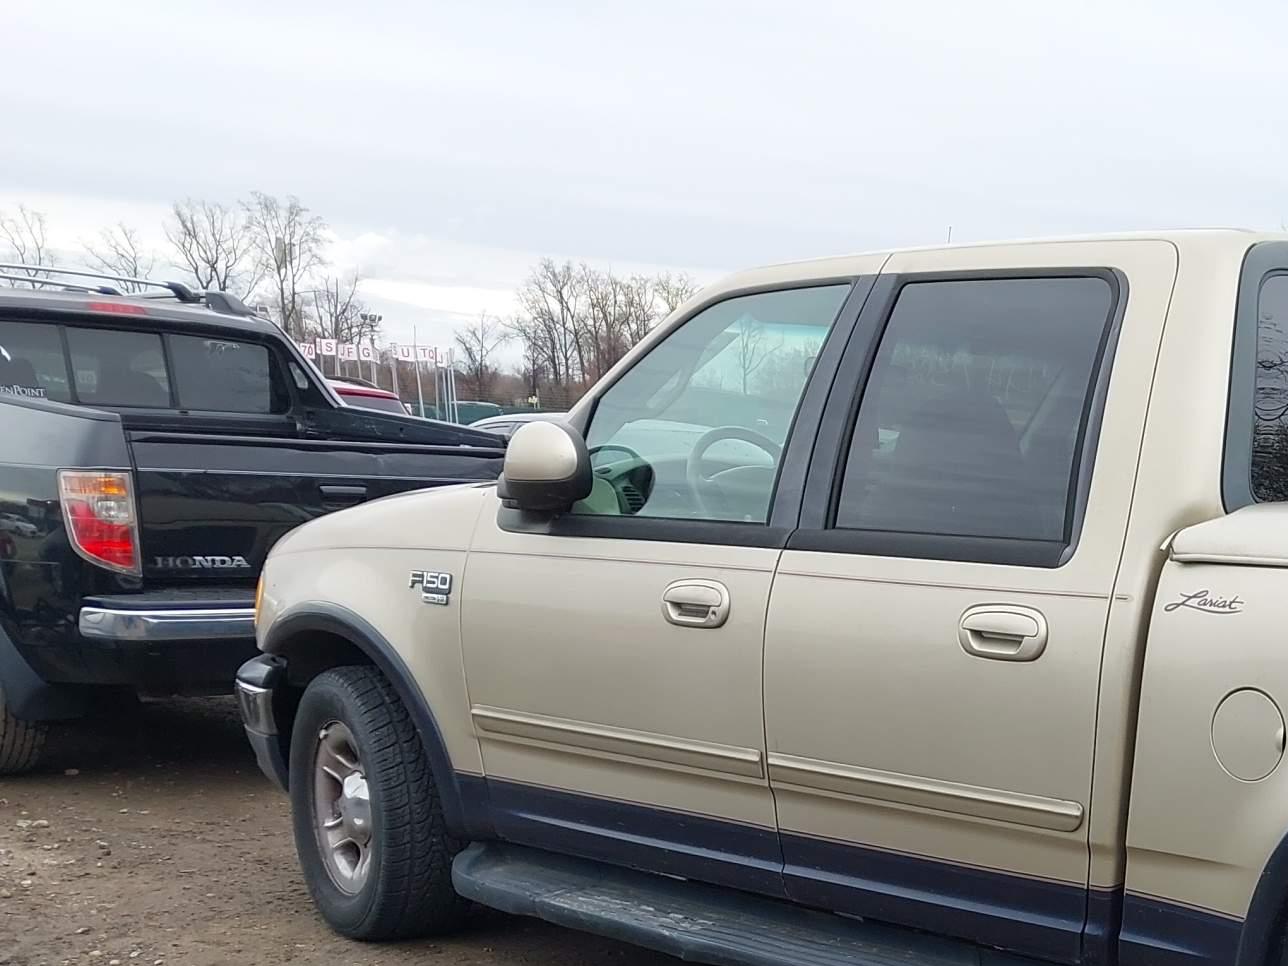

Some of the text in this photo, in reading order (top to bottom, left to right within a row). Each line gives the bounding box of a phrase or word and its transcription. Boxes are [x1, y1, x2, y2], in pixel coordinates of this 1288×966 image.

[362, 347, 370, 358] G
[154, 556, 251, 568] HONDA
[1164, 590, 1244, 614] Lariat
